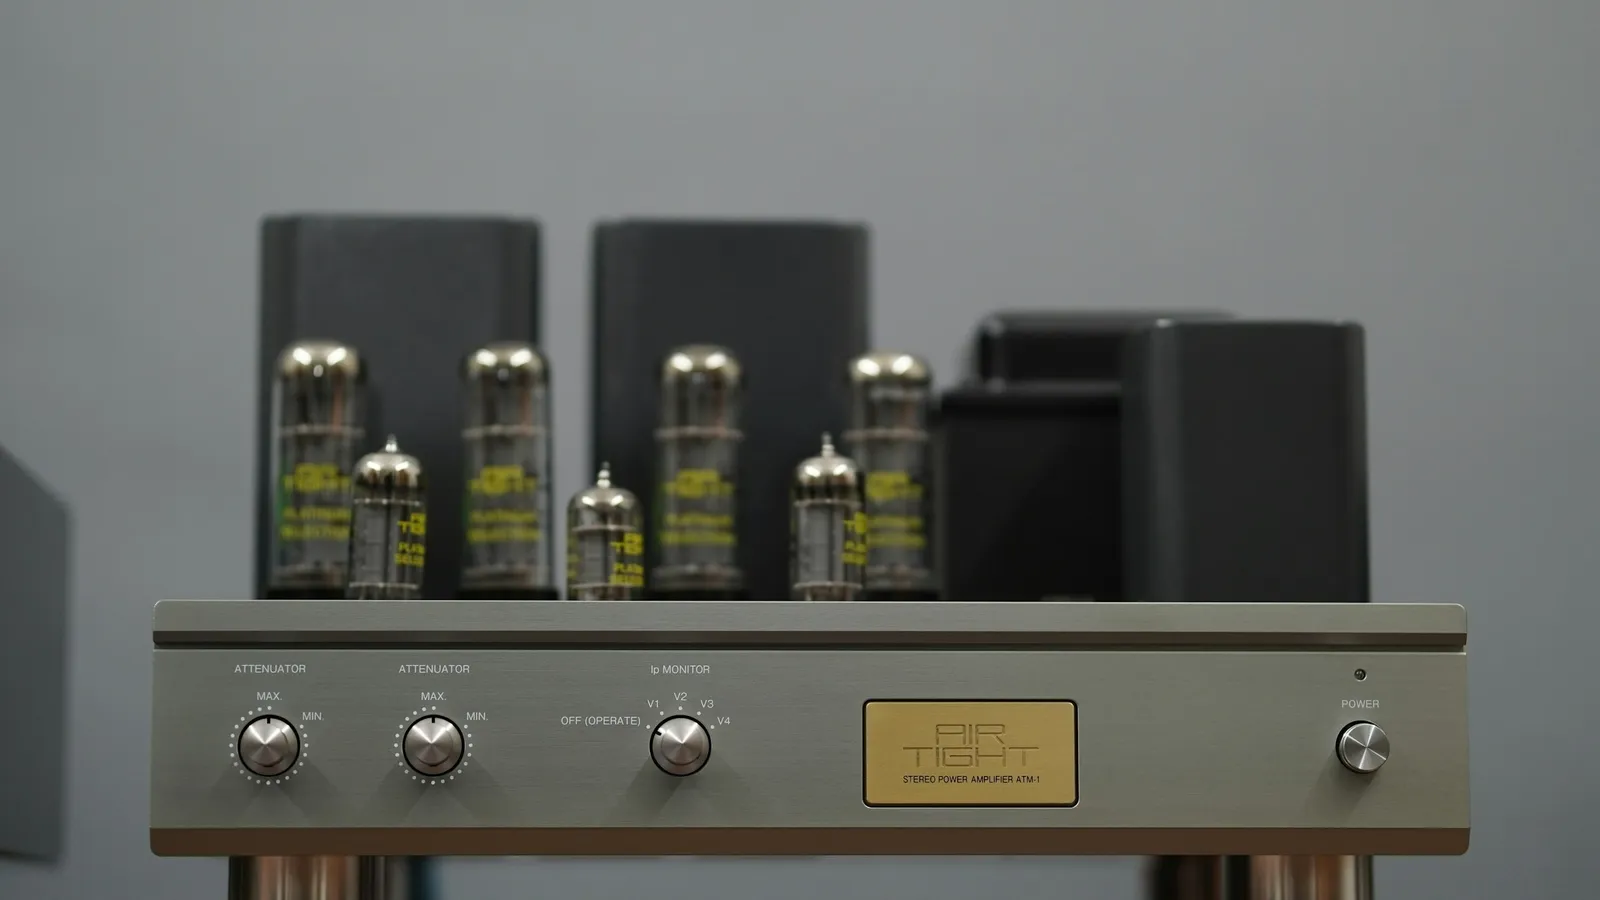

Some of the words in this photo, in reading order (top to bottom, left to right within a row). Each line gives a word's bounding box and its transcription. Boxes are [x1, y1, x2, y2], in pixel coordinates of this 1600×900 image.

[234, 664, 306, 674] ATTENUATOR
[398, 664, 470, 674] ATTENUATOR
[662, 664, 710, 674] MONITOR
[256, 691, 282, 701] MAX.
[420, 691, 447, 701] MAX.
[673, 691, 688, 701] V2
[646, 699, 659, 709] V1
[700, 699, 714, 709] V3
[1341, 699, 1380, 709] POWER
[302, 711, 325, 721] MIN.
[466, 711, 489, 721] MIN.
[716, 716, 731, 726] V4
[560, 716, 582, 726] OFF
[584, 716, 641, 727] (OPERATE)
[936, 723, 1006, 745] AIR
[902, 746, 1040, 768] TIGHT
[902, 775, 936, 784] STEREO
[938, 775, 968, 784] POWER
[970, 775, 1014, 784] AMPLIFIER
[1015, 775, 1040, 784] ATM-1
